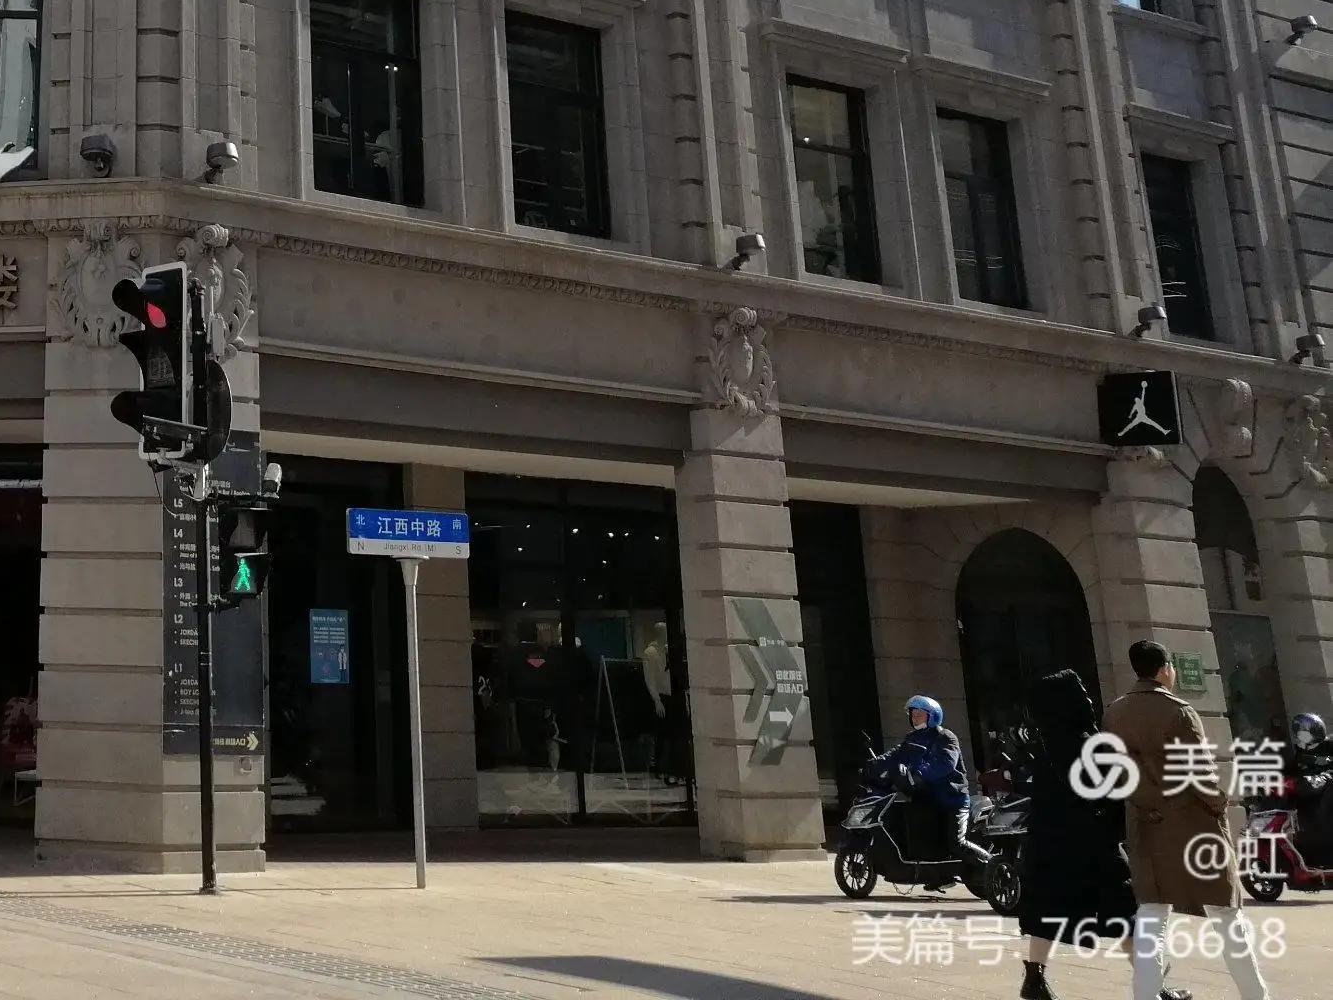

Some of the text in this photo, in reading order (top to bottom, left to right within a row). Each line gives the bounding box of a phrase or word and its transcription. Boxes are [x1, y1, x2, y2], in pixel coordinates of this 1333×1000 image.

[173, 498, 183, 508] L5
[355, 514, 366, 526] 北
[452, 518, 462, 531] 南
[377, 516, 442, 538] 江西中路
[173, 528, 183, 538] L4
[357, 541, 365, 551] N
[383, 543, 409, 552] Jiangxi
[455, 545, 462, 555] S
[173, 578, 183, 588] L3
[173, 614, 184, 624] L2
[174, 663, 183, 673] L1
